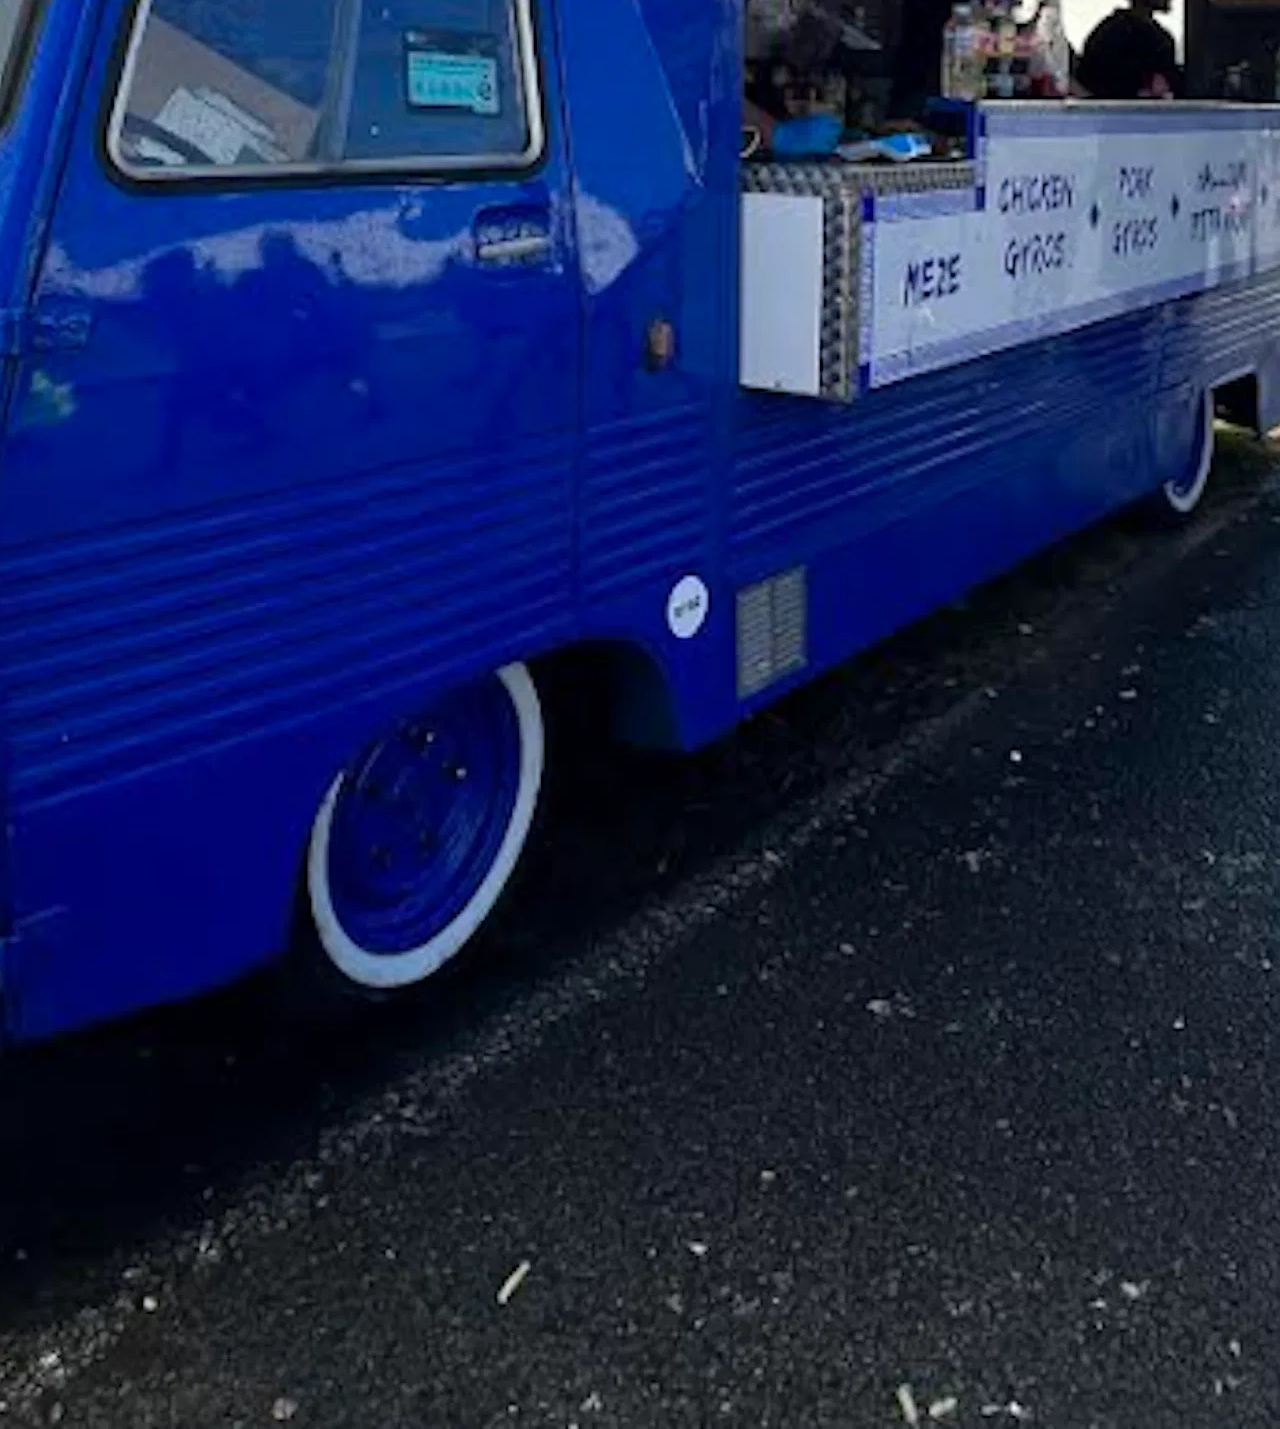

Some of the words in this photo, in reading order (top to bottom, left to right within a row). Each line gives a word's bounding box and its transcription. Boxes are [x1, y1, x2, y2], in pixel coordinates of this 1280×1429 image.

[998, 173, 1077, 215] CHICKEN
[902, 253, 962, 309] MEZE
[1004, 231, 1067, 280] GYROS
